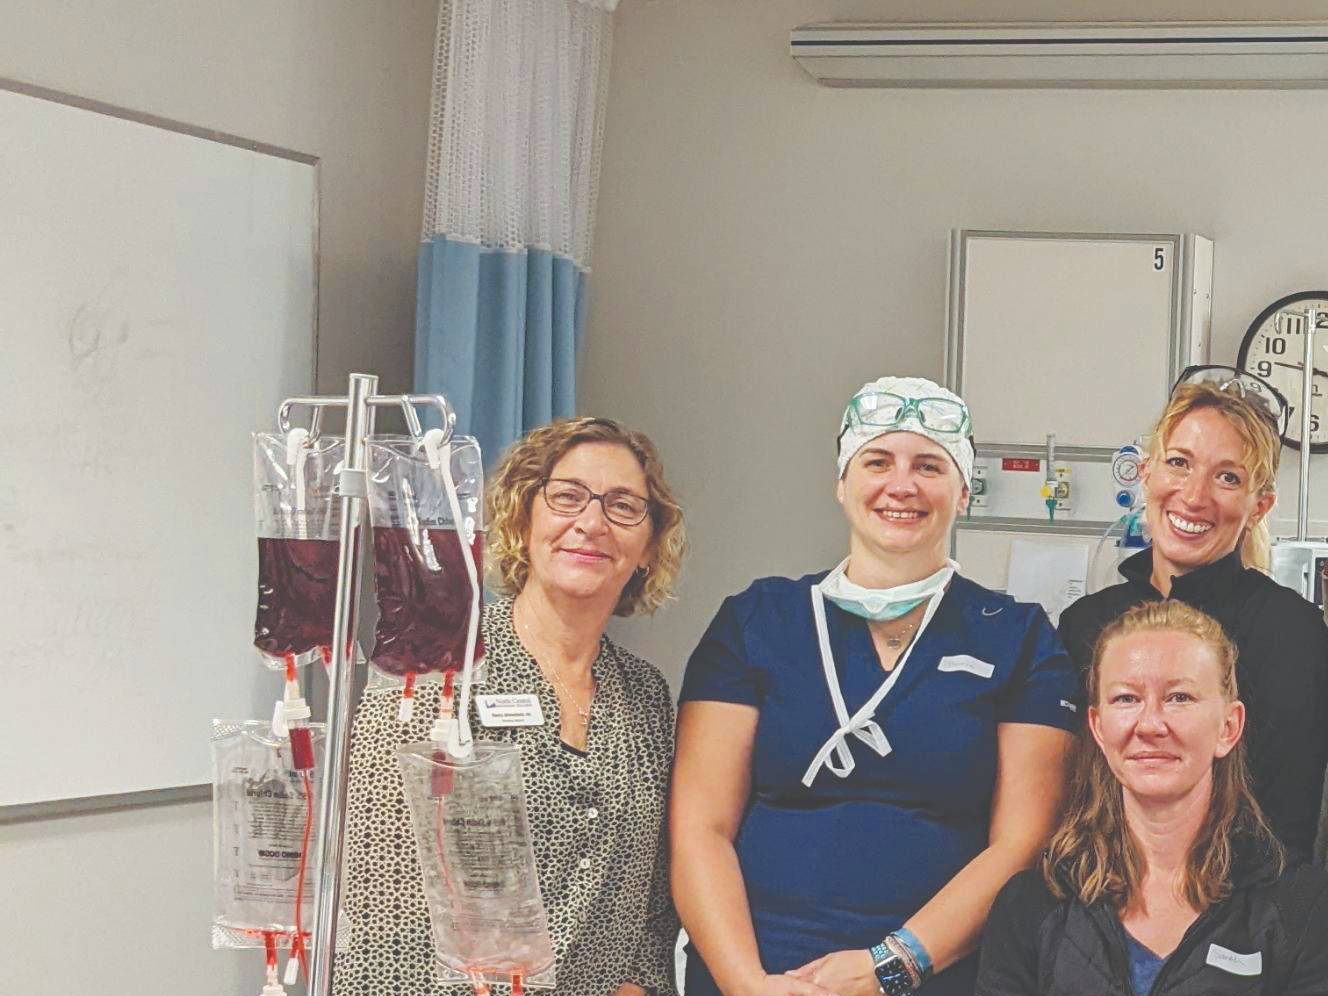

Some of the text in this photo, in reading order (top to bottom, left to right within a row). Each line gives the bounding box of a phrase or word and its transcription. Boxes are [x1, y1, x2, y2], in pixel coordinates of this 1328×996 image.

[1154, 247, 1164, 271] 5
[1265, 337, 1287, 355] 10
[1257, 360, 1272, 378] 9
